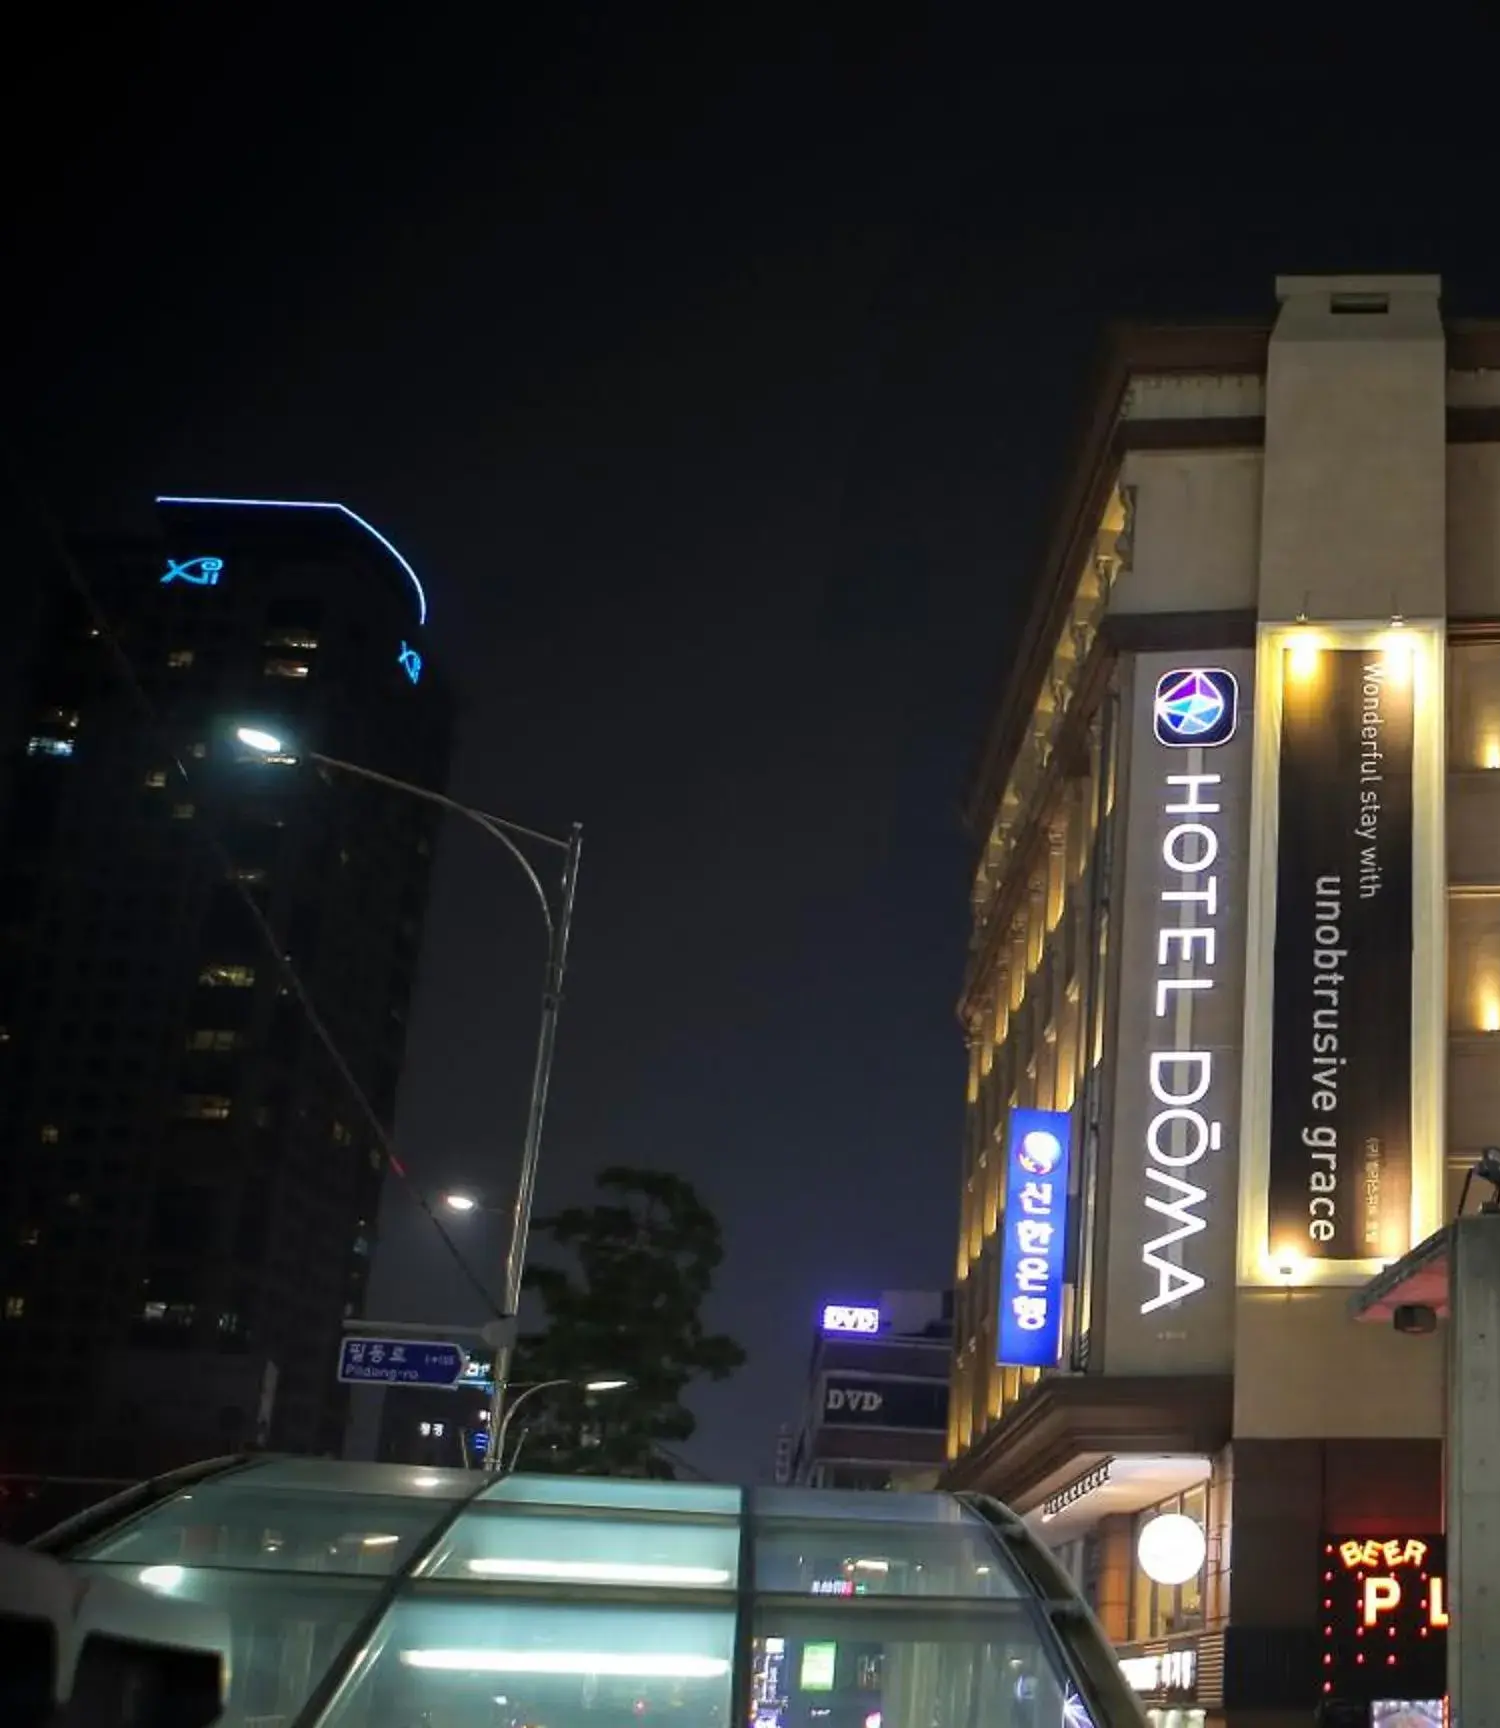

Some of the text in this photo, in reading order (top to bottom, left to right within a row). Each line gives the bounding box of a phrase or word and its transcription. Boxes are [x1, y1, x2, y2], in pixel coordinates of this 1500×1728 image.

[1155, 774, 1221, 1018] HOTEL
[1354, 663, 1384, 899] Wonderful stay with
[1301, 874, 1348, 1242] unobtrusive grace
[827, 1388, 882, 1412] DVD
[1339, 1538, 1427, 1568] BEER
